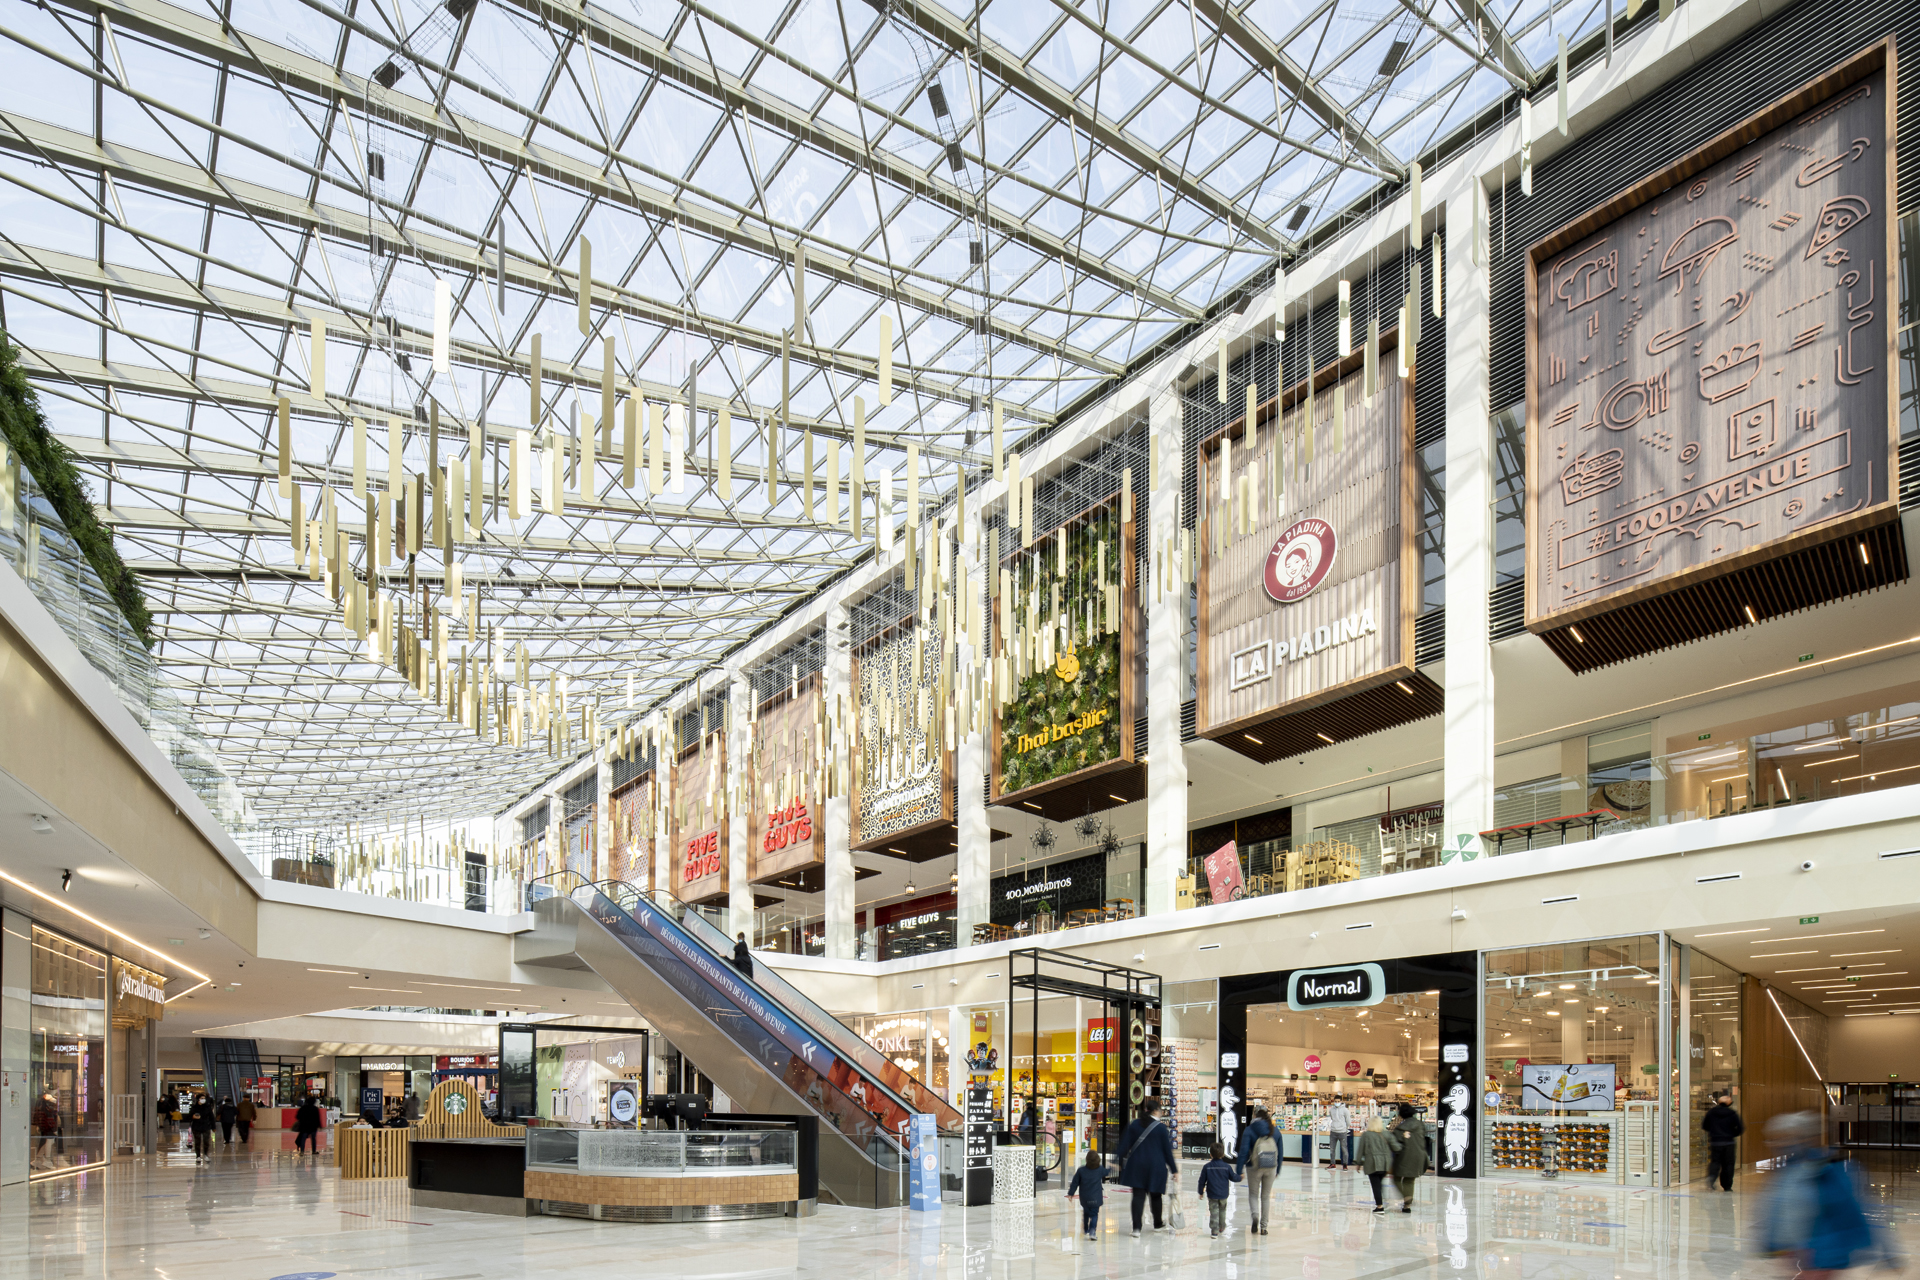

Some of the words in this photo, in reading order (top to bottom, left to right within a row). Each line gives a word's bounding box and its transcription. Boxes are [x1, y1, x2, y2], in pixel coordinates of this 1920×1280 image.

[1588, 453, 1811, 552] #FOODAVENUE
[1271, 541, 1286, 557] LA
[1285, 521, 1327, 542] PIADINA
[1286, 587, 1296, 598] dal
[1296, 581, 1312, 594] 1994
[1235, 650, 1265, 681] LA
[1275, 607, 1377, 666] PIADINA
[1017, 726, 1050, 754] Thai
[1052, 708, 1107, 742] basilic
[768, 793, 807, 828] FIVE
[687, 831, 718, 861] FIVE
[763, 817, 812, 853] GUYS
[683, 852, 721, 882] GUYS
[1005, 889, 1022, 900] 100
[1022, 877, 1072, 897] MONTADITOS
[900, 917, 917, 929] FIVE
[918, 912, 940, 925] GUYS
[812, 936, 826, 947] FIVE
[122, 973, 165, 1005] stradivarius
[660, 926, 689, 955] DÉCOUVREZ
[687, 947, 697, 963] LES
[696, 956, 733, 992] RESTAURANTS
[732, 985, 742, 998] DE
[740, 991, 748, 1005] LA
[748, 998, 764, 1016] FOOD
[763, 1011, 787, 1035] AVENUE
[1304, 976, 1361, 999] Normal
[1089, 1027, 1114, 1042] LEGO
[366, 1062, 398, 1071] MANGO
[1591, 1084, 1606, 1092] 7.20
